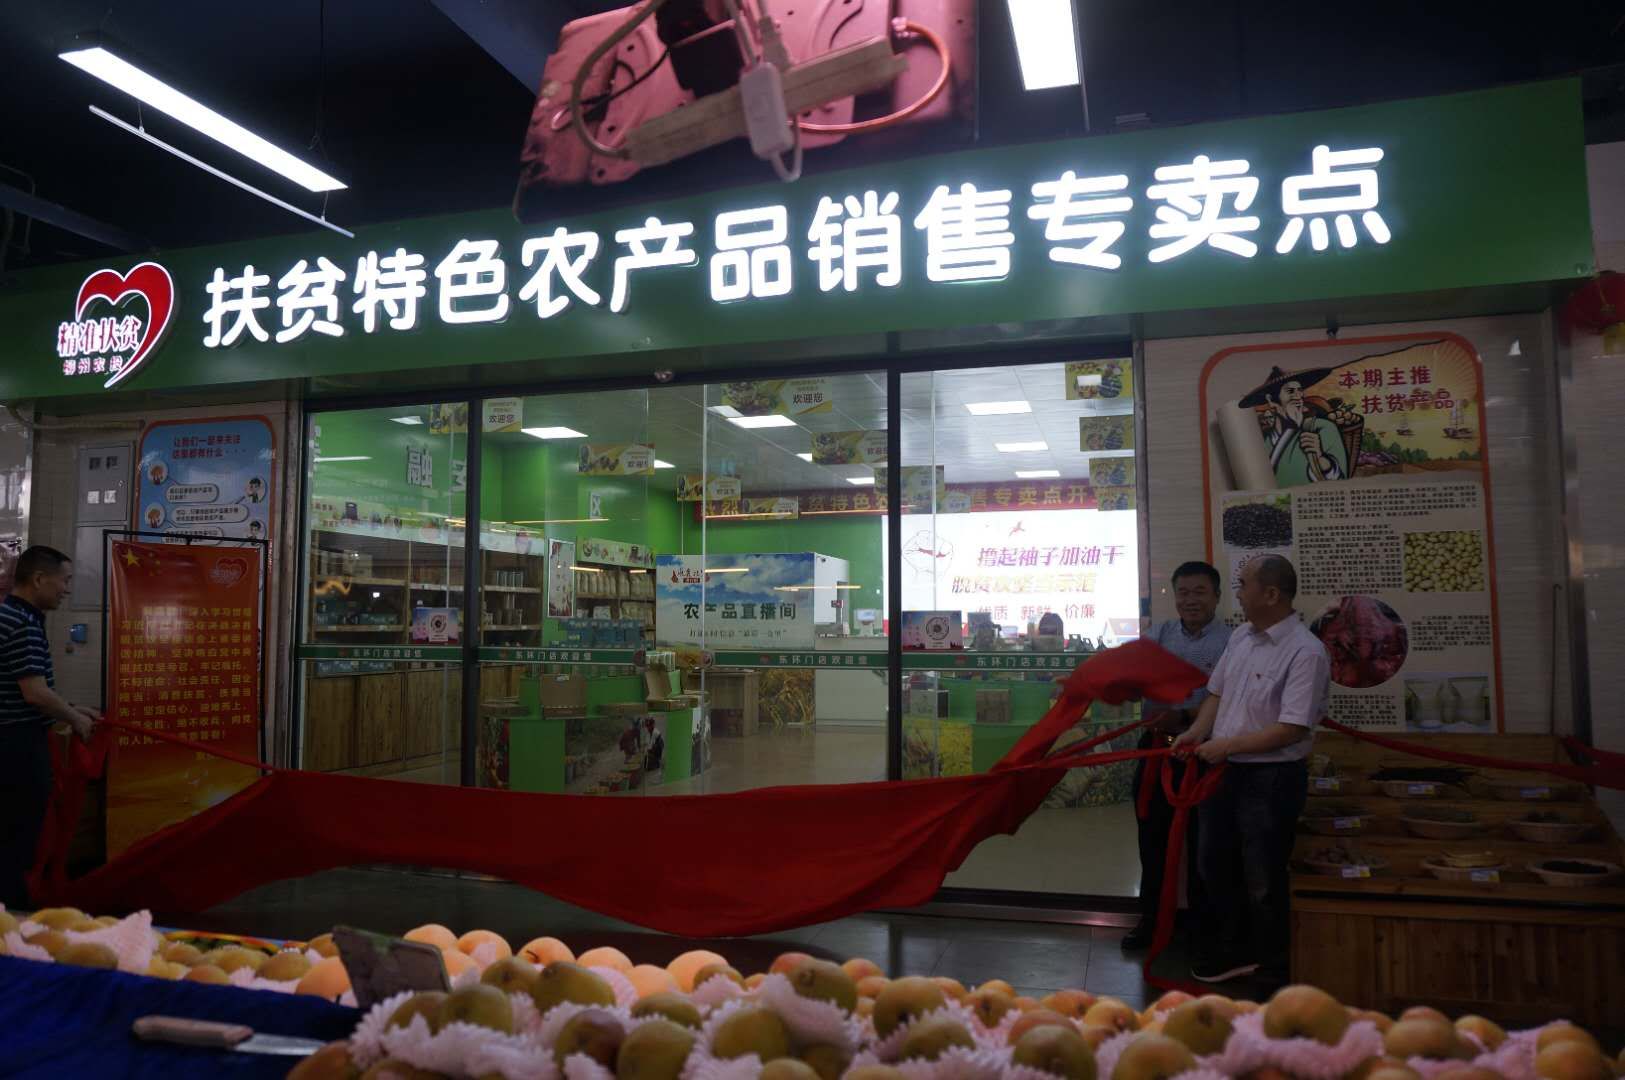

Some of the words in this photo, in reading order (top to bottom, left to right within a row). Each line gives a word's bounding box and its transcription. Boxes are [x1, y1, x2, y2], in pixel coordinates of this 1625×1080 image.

[203, 145, 1391, 348] 扶贫特色农产品销售专卖点
[57, 315, 141, 357] 精准扶贫
[1338, 365, 1432, 389] 本期主推
[1361, 388, 1455, 414] 扶贫产品
[977, 545, 1126, 568] 撸起袖子加油干
[684, 602, 797, 621] 农产品直播间
[1064, 603, 1096, 619] 价廉
